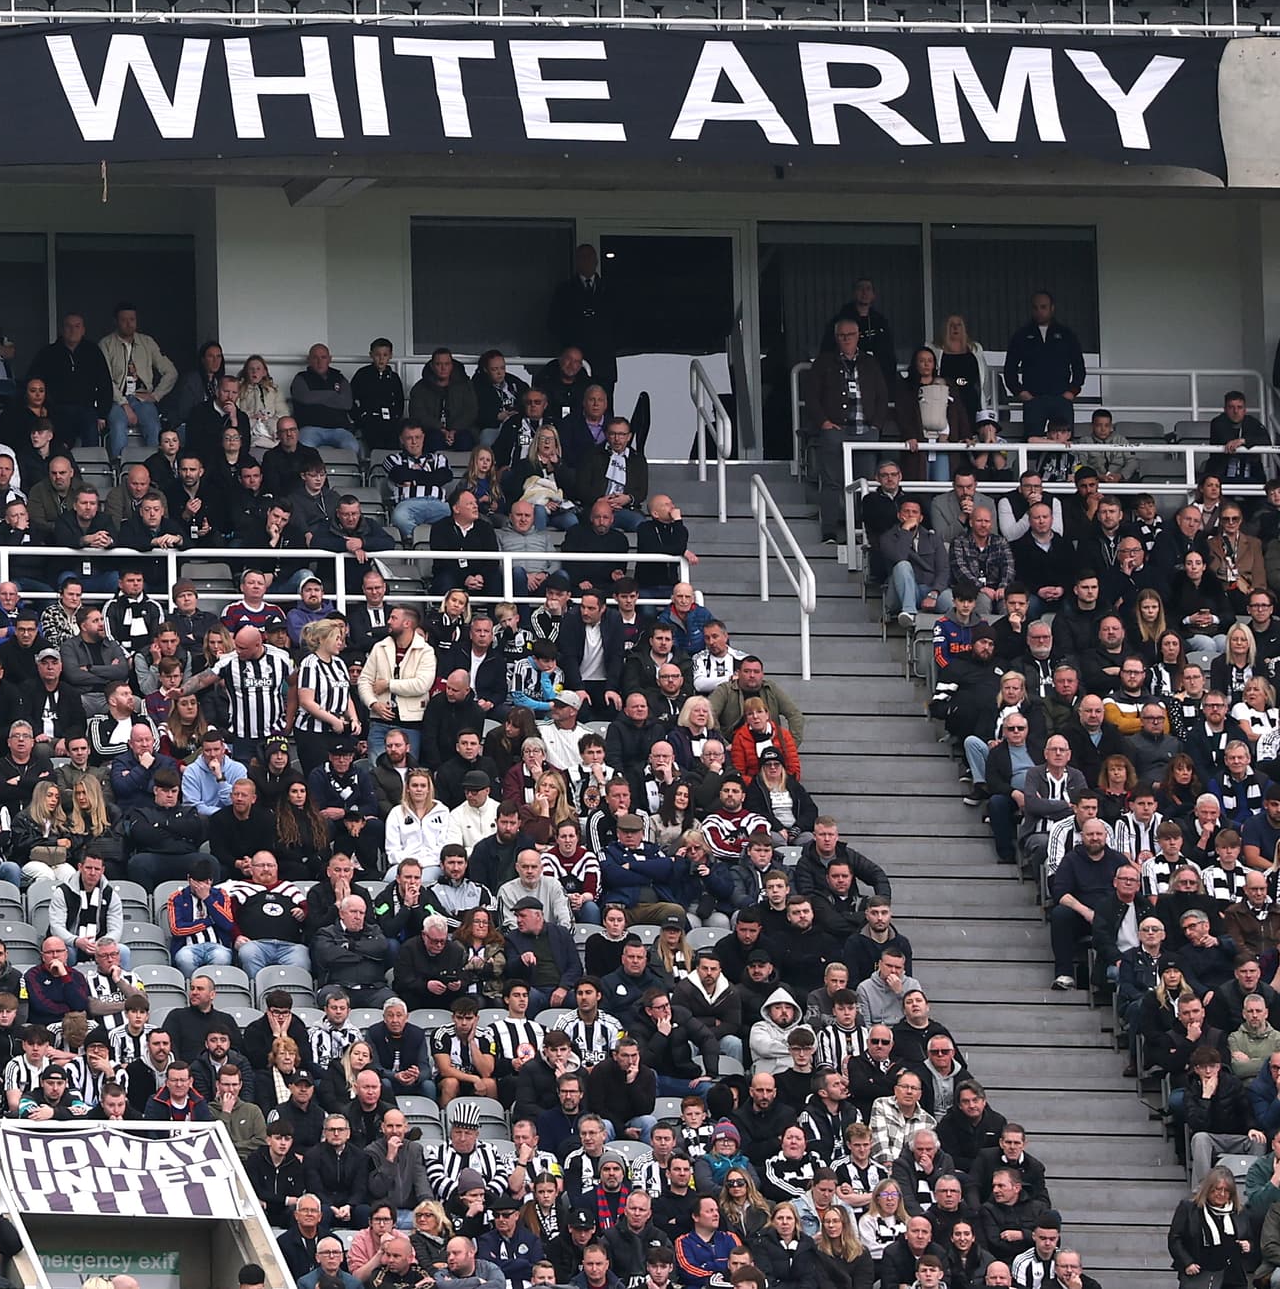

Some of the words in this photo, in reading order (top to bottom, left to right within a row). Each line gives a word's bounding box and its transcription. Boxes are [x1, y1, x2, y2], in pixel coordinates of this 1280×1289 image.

[45, 34, 626, 141] WHITE
[670, 41, 1184, 150] ARMY
[254, 676, 272, 687] sela
[5, 1129, 210, 1172] HOWAY
[14, 1157, 229, 1196] UNITED
[140, 1252, 176, 1270] exit
